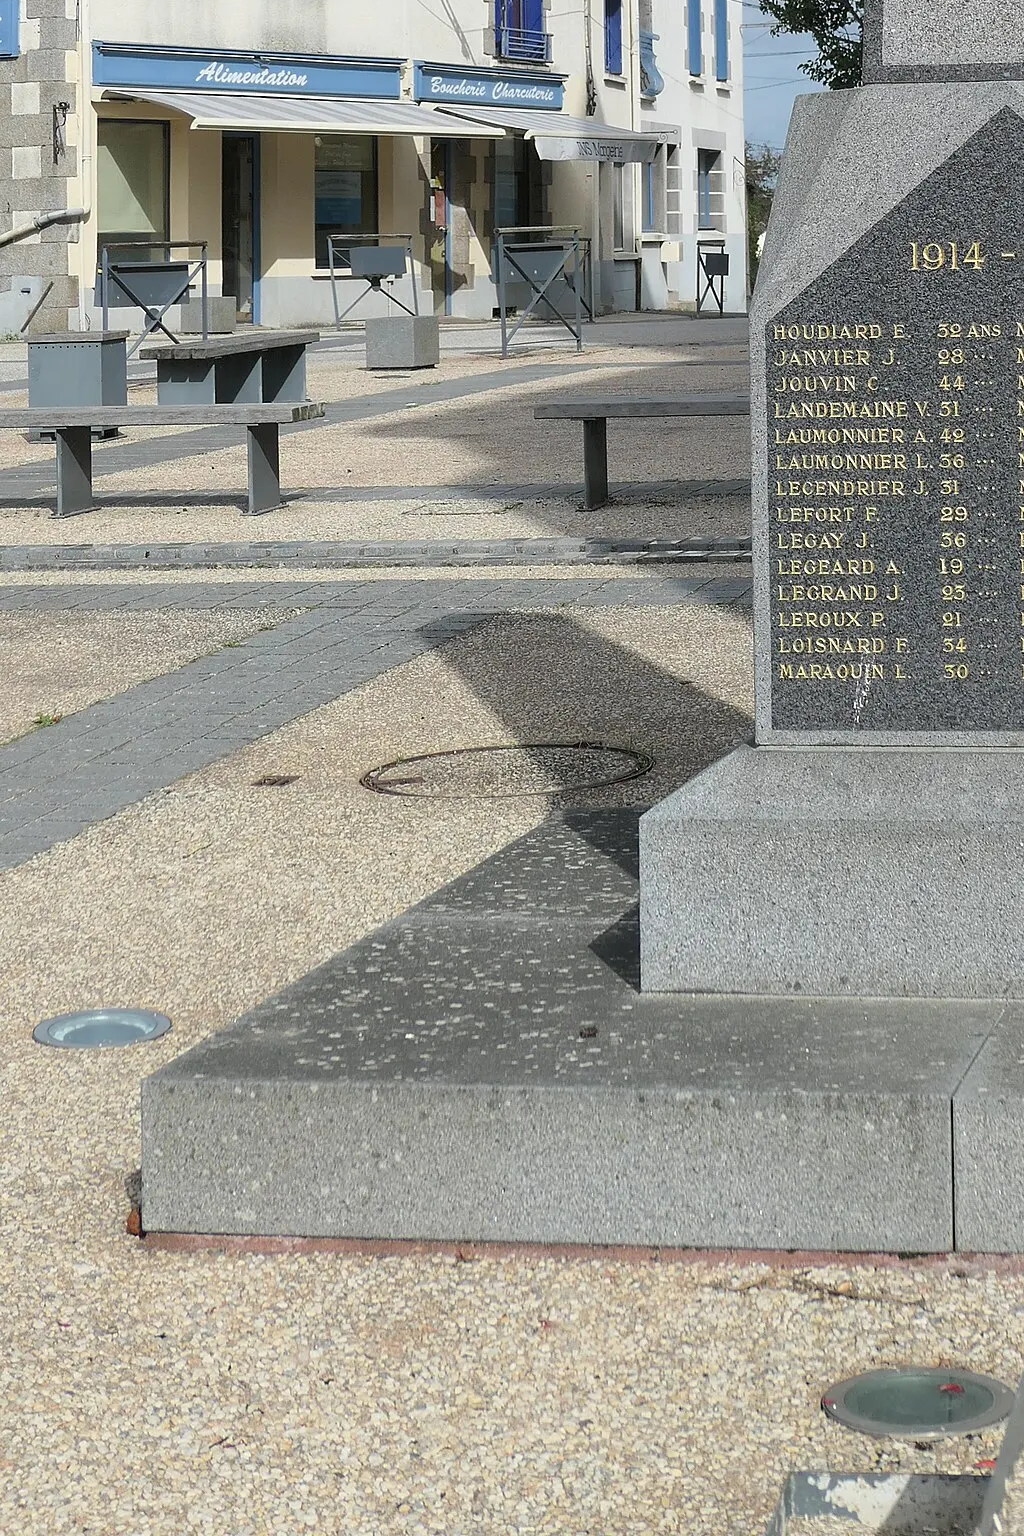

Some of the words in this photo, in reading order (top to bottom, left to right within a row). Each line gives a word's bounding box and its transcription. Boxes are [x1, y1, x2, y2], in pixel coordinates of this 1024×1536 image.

[195, 62, 308, 86] Alimentation
[430, 76, 486, 97] Boucherie
[492, 82, 554, 101] Charcuterie
[910, 241, 987, 270] 1914
[773, 325, 882, 339] HOUDIARD
[893, 325, 912, 339] E.
[937, 324, 961, 338] 32
[967, 325, 1001, 337] ANS
[774, 350, 870, 365] JANVIER
[882, 349, 901, 365] J.
[938, 349, 964, 364] 28
[775, 377, 856, 391] JOUVIN
[868, 377, 889, 391] C.
[939, 376, 965, 391] 44
[774, 402, 907, 418] LANDEMAINE
[915, 402, 930, 416] V.
[939, 402, 960, 416] 31
[775, 428, 905, 444] LAUMONNIER
[914, 430, 934, 443] A.
[940, 428, 965, 443] 42
[775, 455, 907, 470] LAUMONNIER
[917, 454, 934, 469] L.
[939, 454, 964, 469] 36
[913, 481, 929, 496] J.
[940, 480, 959, 495] 31
[776, 508, 854, 522] LEFORT
[866, 508, 880, 521] F.
[941, 507, 968, 521] 29
[856, 533, 875, 548] J.
[940, 533, 966, 548] 36
[886, 561, 905, 574] A.
[940, 558, 963, 574] 19
[778, 586, 878, 601] LEGRAND
[886, 586, 904, 601] J.
[942, 586, 966, 600] 23
[779, 613, 862, 627] LEROUX
[871, 613, 887, 626] P.
[943, 612, 962, 626] 21
[779, 638, 884, 653] LOISNARD
[897, 638, 910, 653] F.
[943, 638, 967, 653] 34
[780, 665, 884, 681] MARAQUIN
[895, 665, 912, 679] L.
[944, 665, 968, 679] 30
